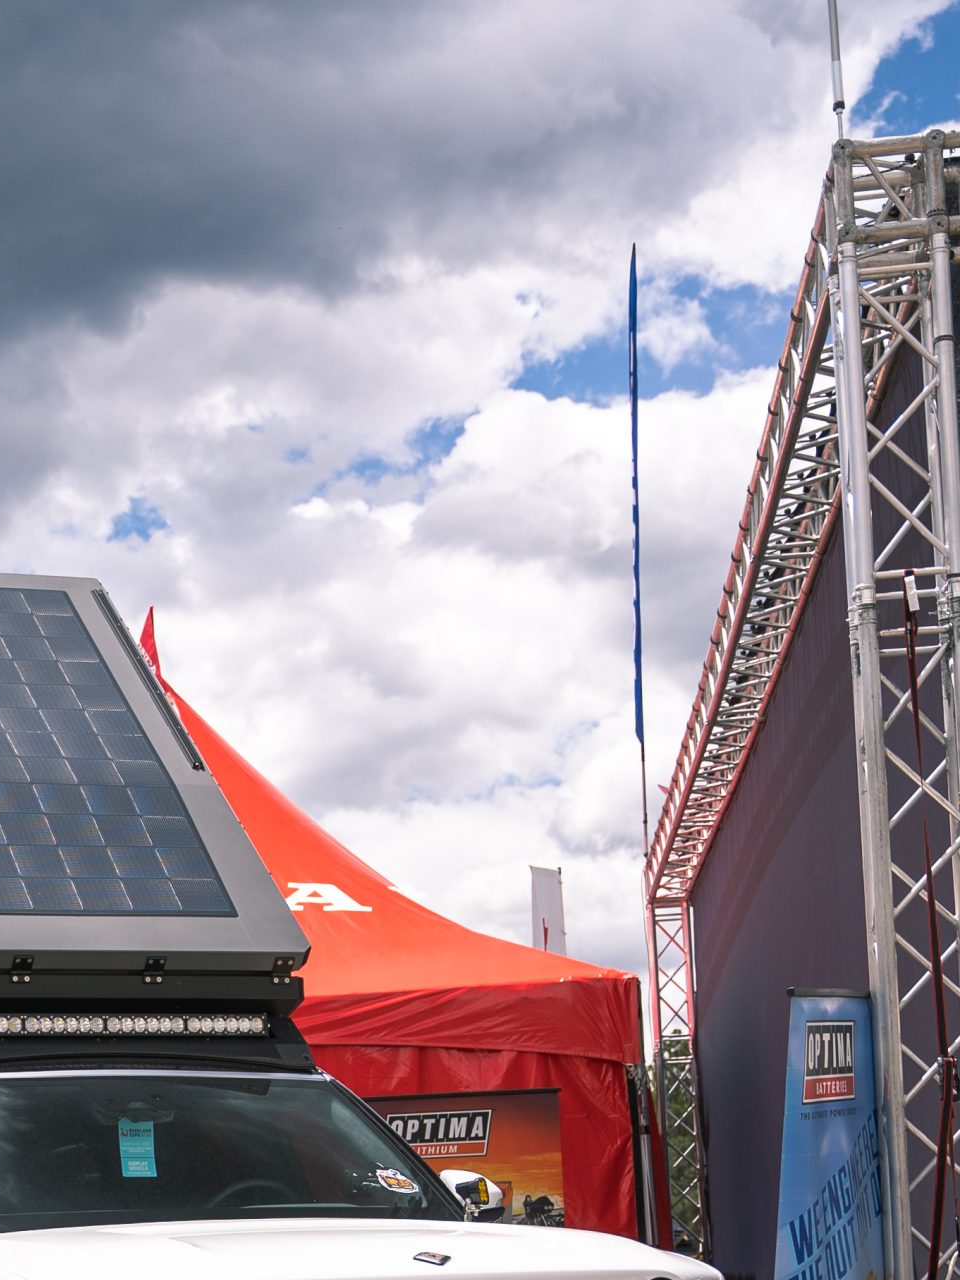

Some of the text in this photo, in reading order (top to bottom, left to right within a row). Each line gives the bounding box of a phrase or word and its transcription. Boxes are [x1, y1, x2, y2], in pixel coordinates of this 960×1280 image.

[808, 1032, 852, 1070] OPTIMA
[816, 1081, 847, 1095] BATTERIES
[391, 1116, 484, 1140] OPTIMA
[416, 1145, 458, 1155] ITHIUM
[789, 1200, 822, 1265] WE
